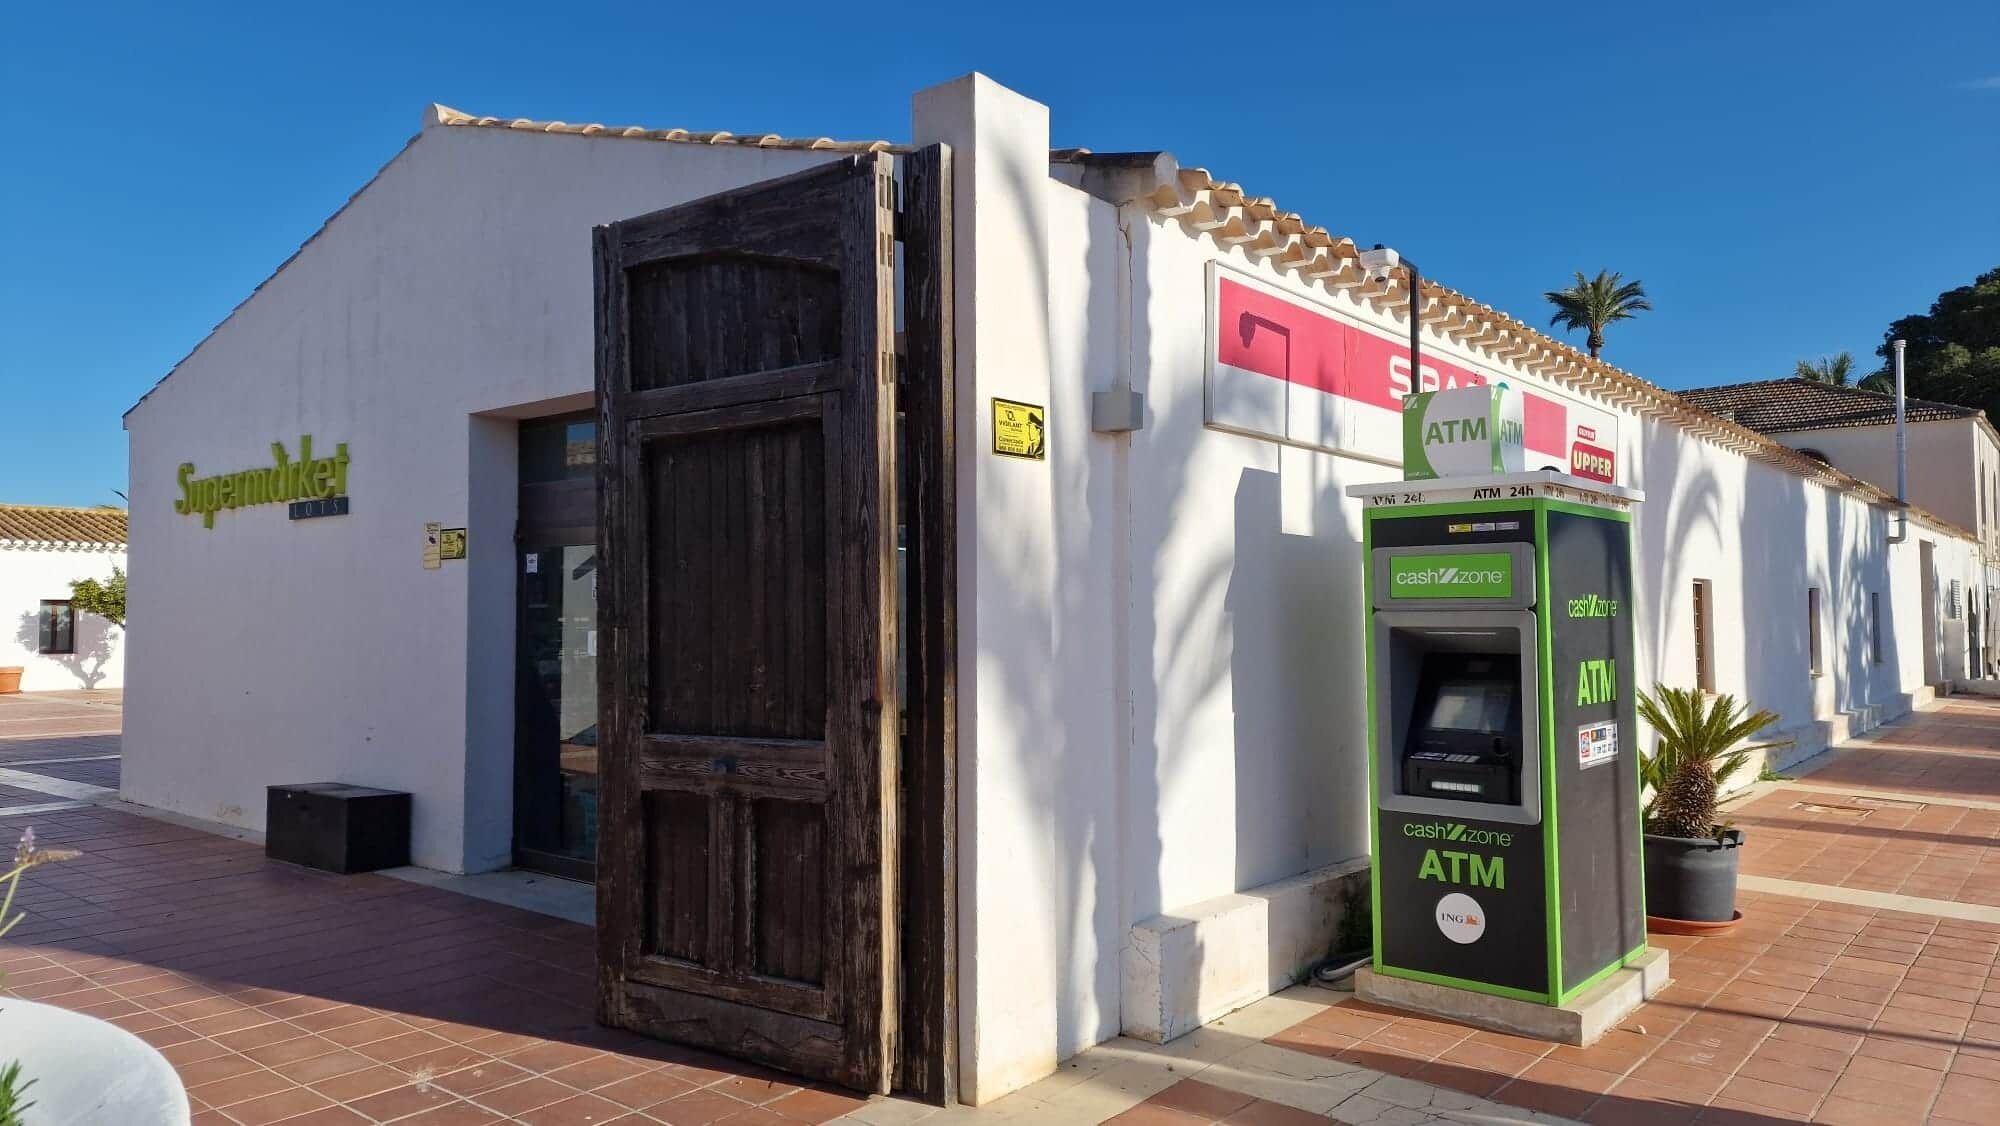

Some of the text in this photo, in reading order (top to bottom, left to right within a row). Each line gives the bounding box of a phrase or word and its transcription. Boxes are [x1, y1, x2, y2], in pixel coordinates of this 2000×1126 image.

[1425, 417, 1487, 445] ATM
[1500, 419, 1523, 447] ATM
[1574, 450, 1612, 477] UPPER
[1473, 485, 1534, 499] ATM 24h
[294, 501, 339, 518] LOTS
[1577, 659, 1617, 706] ATM
[1418, 849, 1505, 890] ATM
[1441, 912, 1464, 923] ING
